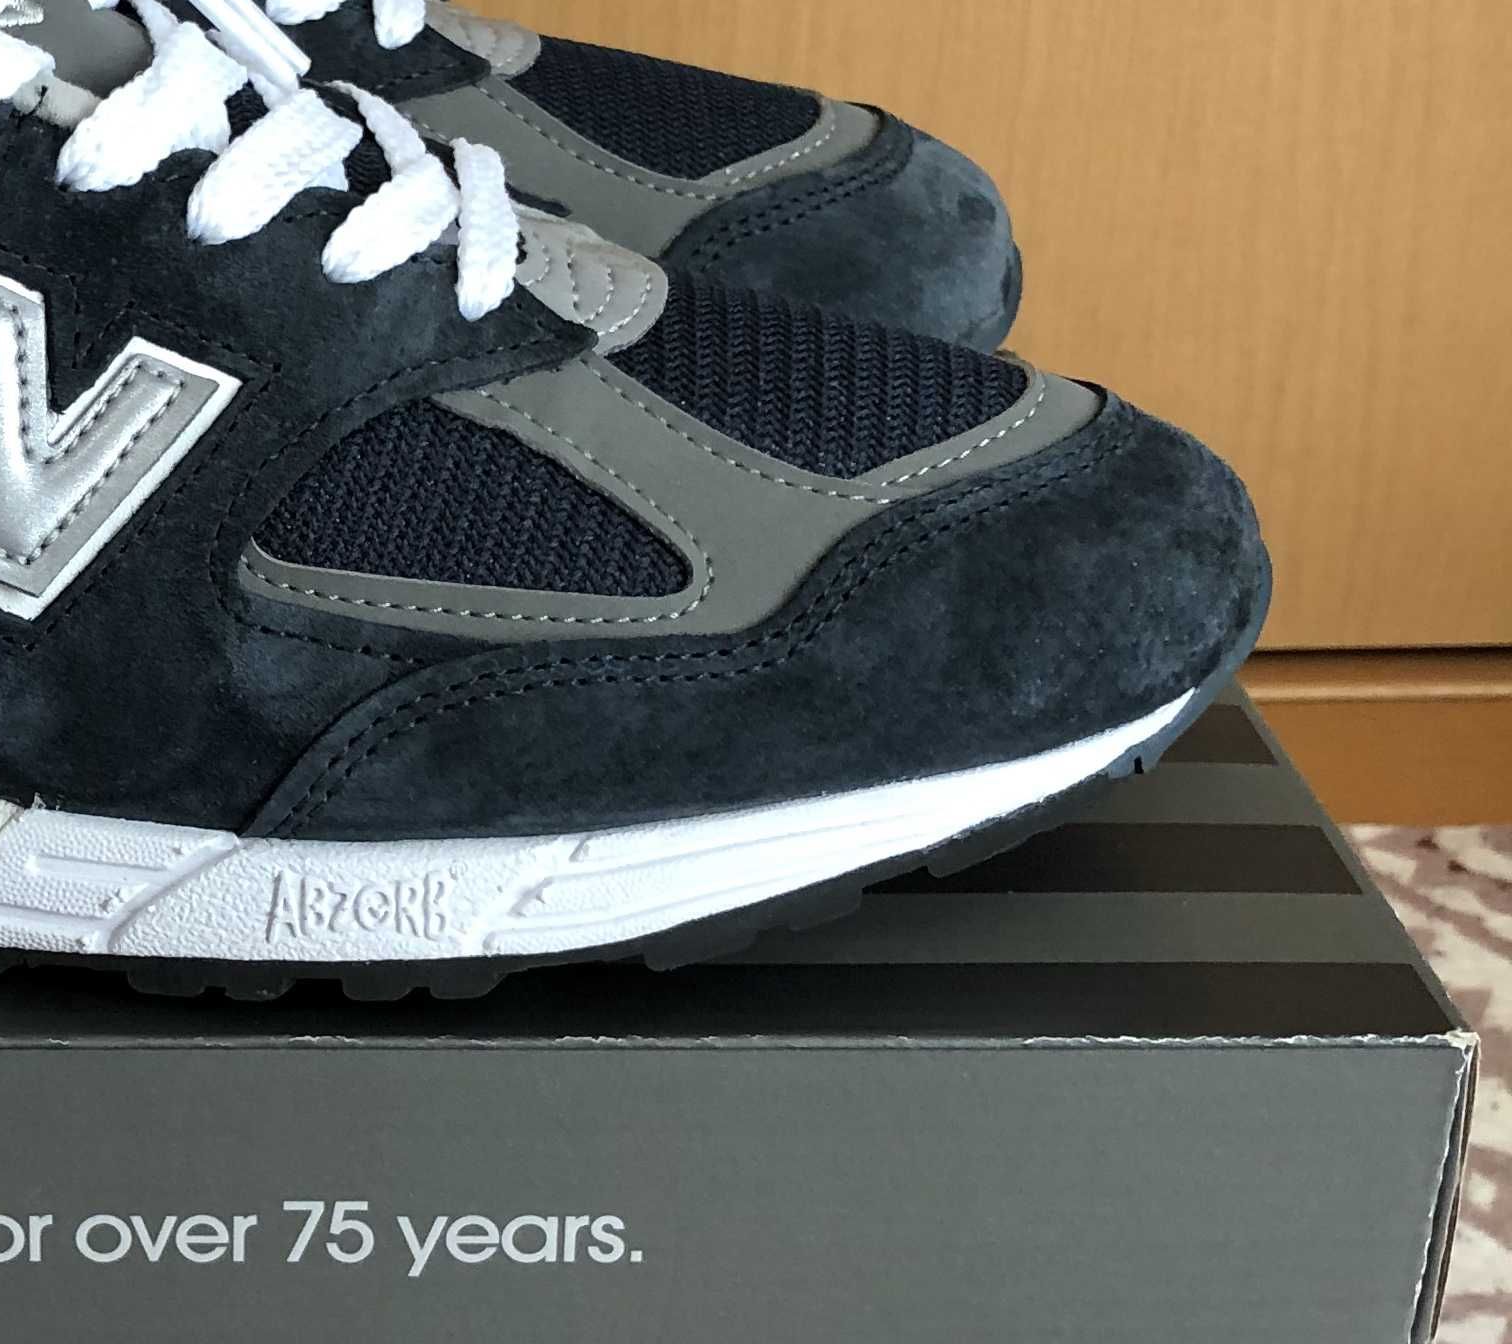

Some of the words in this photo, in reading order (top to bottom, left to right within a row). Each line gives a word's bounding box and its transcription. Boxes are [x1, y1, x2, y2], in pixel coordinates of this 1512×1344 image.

[75, 1214, 258, 1263] over
[283, 1200, 375, 1264] 75
[396, 1214, 644, 1278] years.
